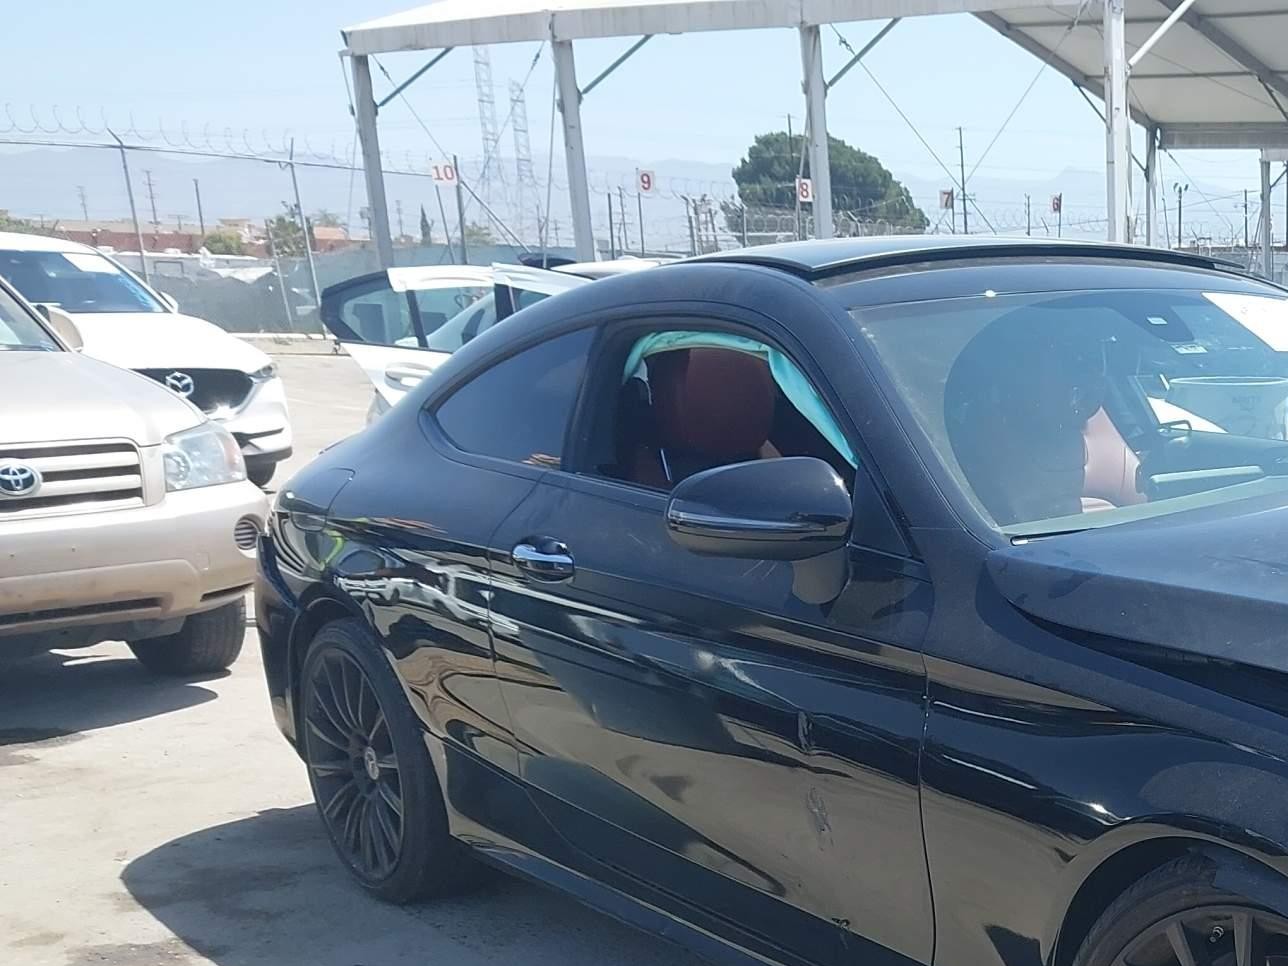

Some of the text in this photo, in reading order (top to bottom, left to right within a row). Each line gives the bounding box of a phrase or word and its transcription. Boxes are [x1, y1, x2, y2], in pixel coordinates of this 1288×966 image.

[432, 164, 455, 181] 10
[640, 173, 651, 190] 9
[800, 182, 809, 199] 8
[943, 192, 952, 207] 7
[1053, 197, 1060, 211] 6
